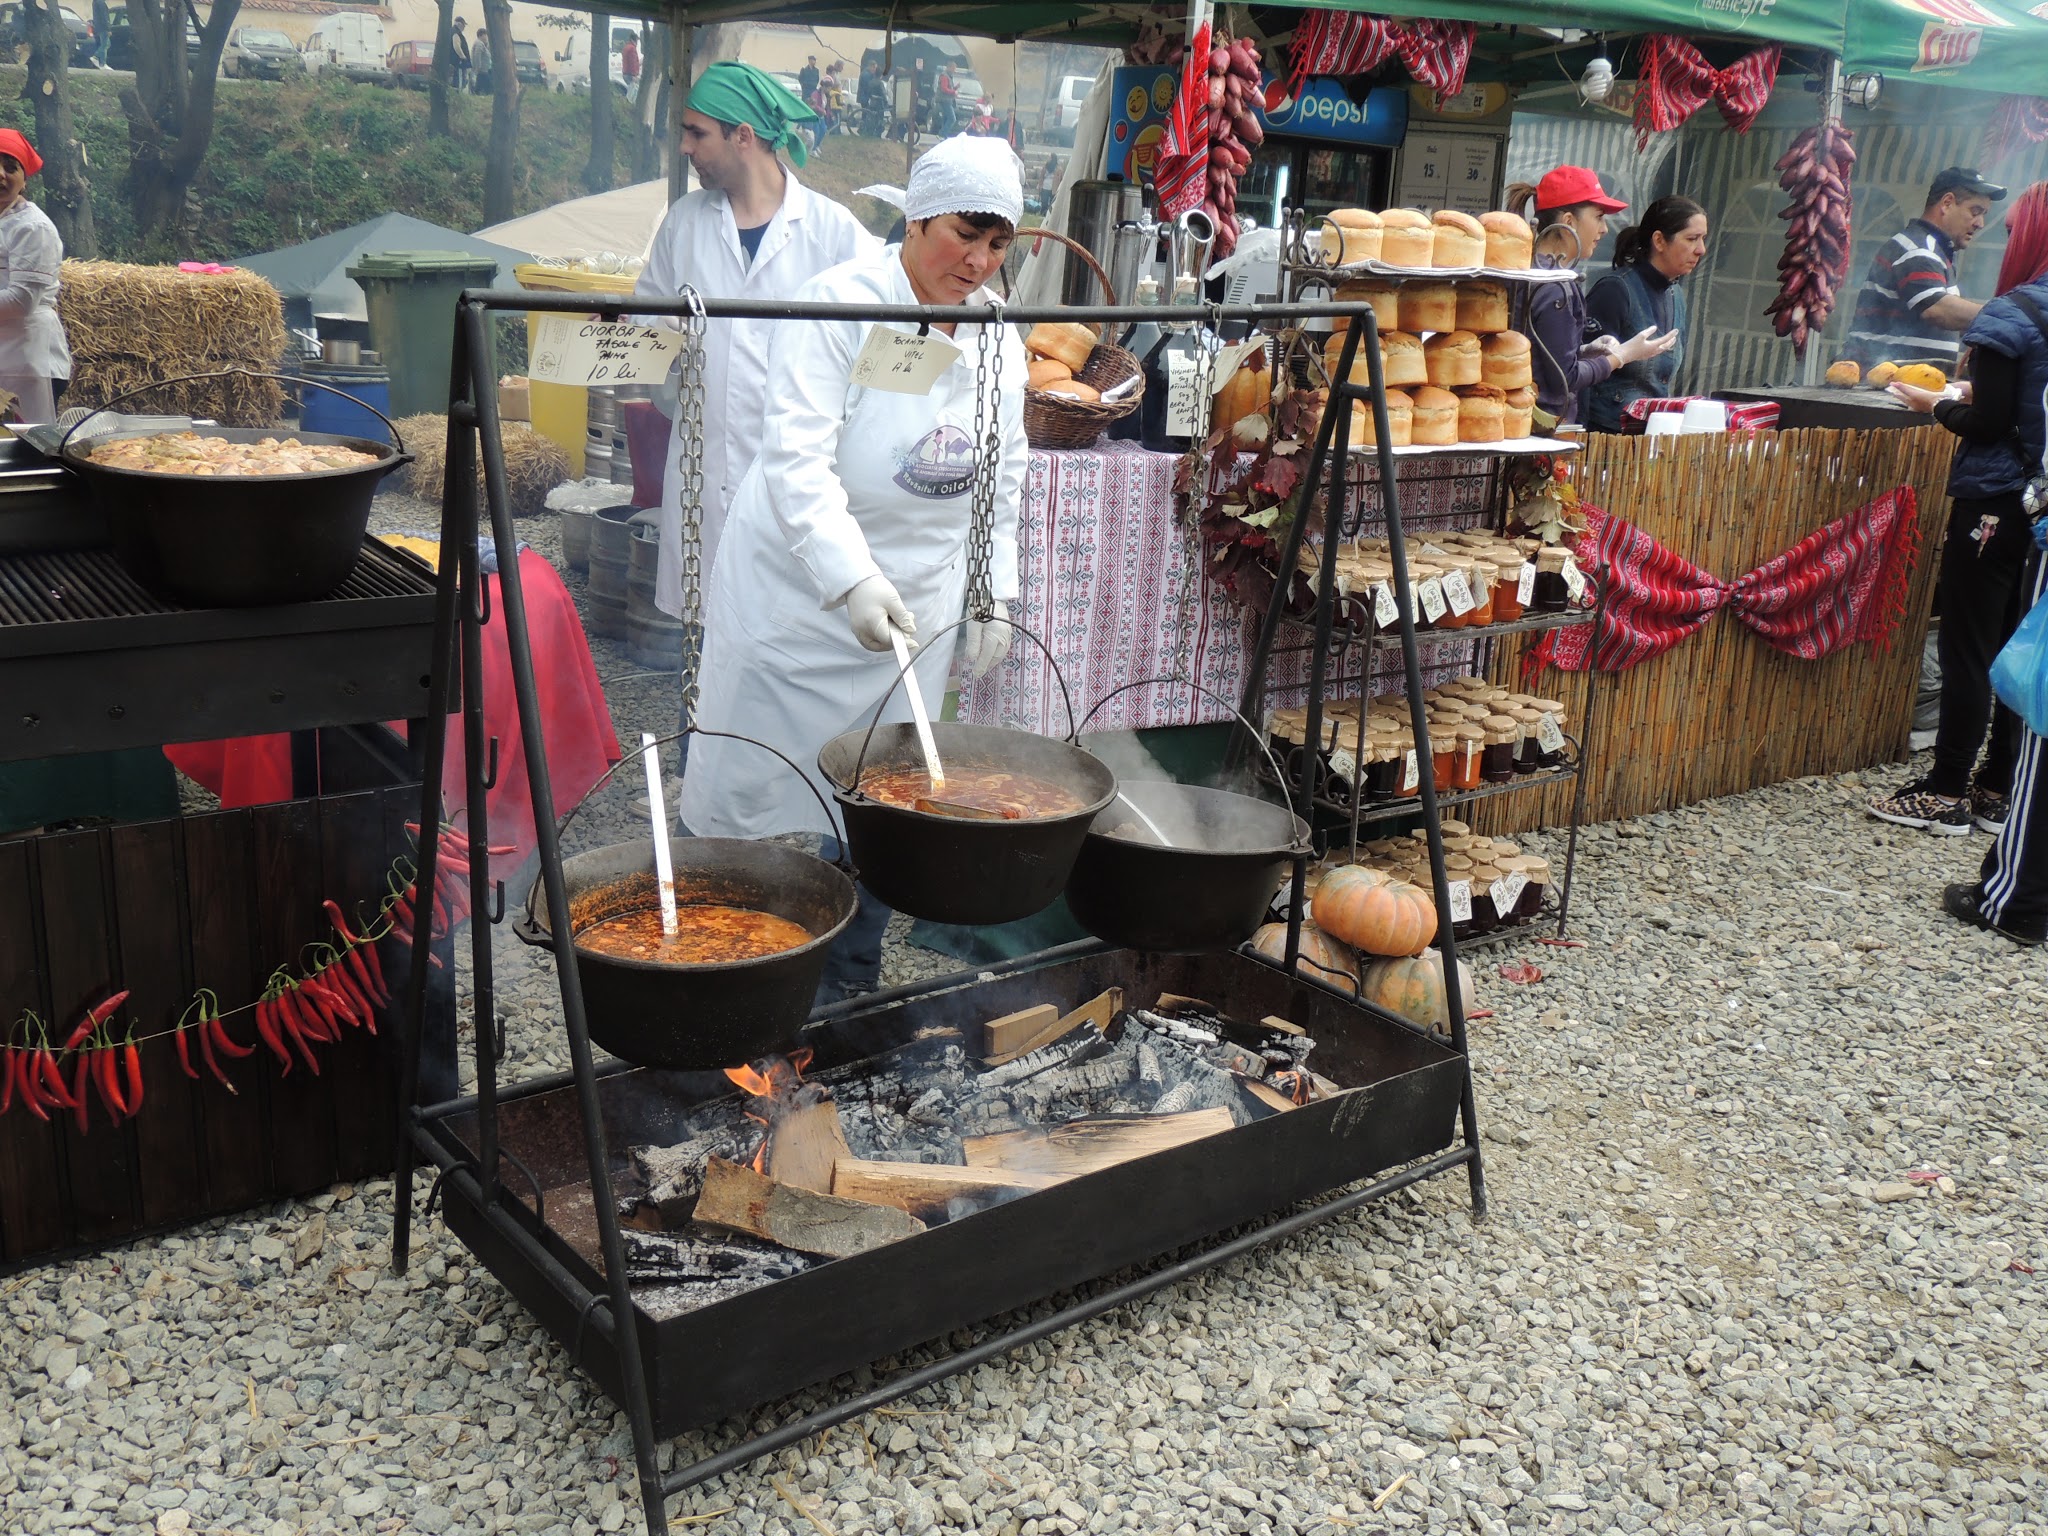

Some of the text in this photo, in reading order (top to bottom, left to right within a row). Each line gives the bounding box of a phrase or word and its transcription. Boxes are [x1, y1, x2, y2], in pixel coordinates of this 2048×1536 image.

[1299, 95, 1368, 127] pepsi
[1423, 163, 1435, 178] 15
[595, 339, 641, 349] FASOLE
[586, 362, 641, 382] 10 lei
[940, 477, 973, 494] Oilor
